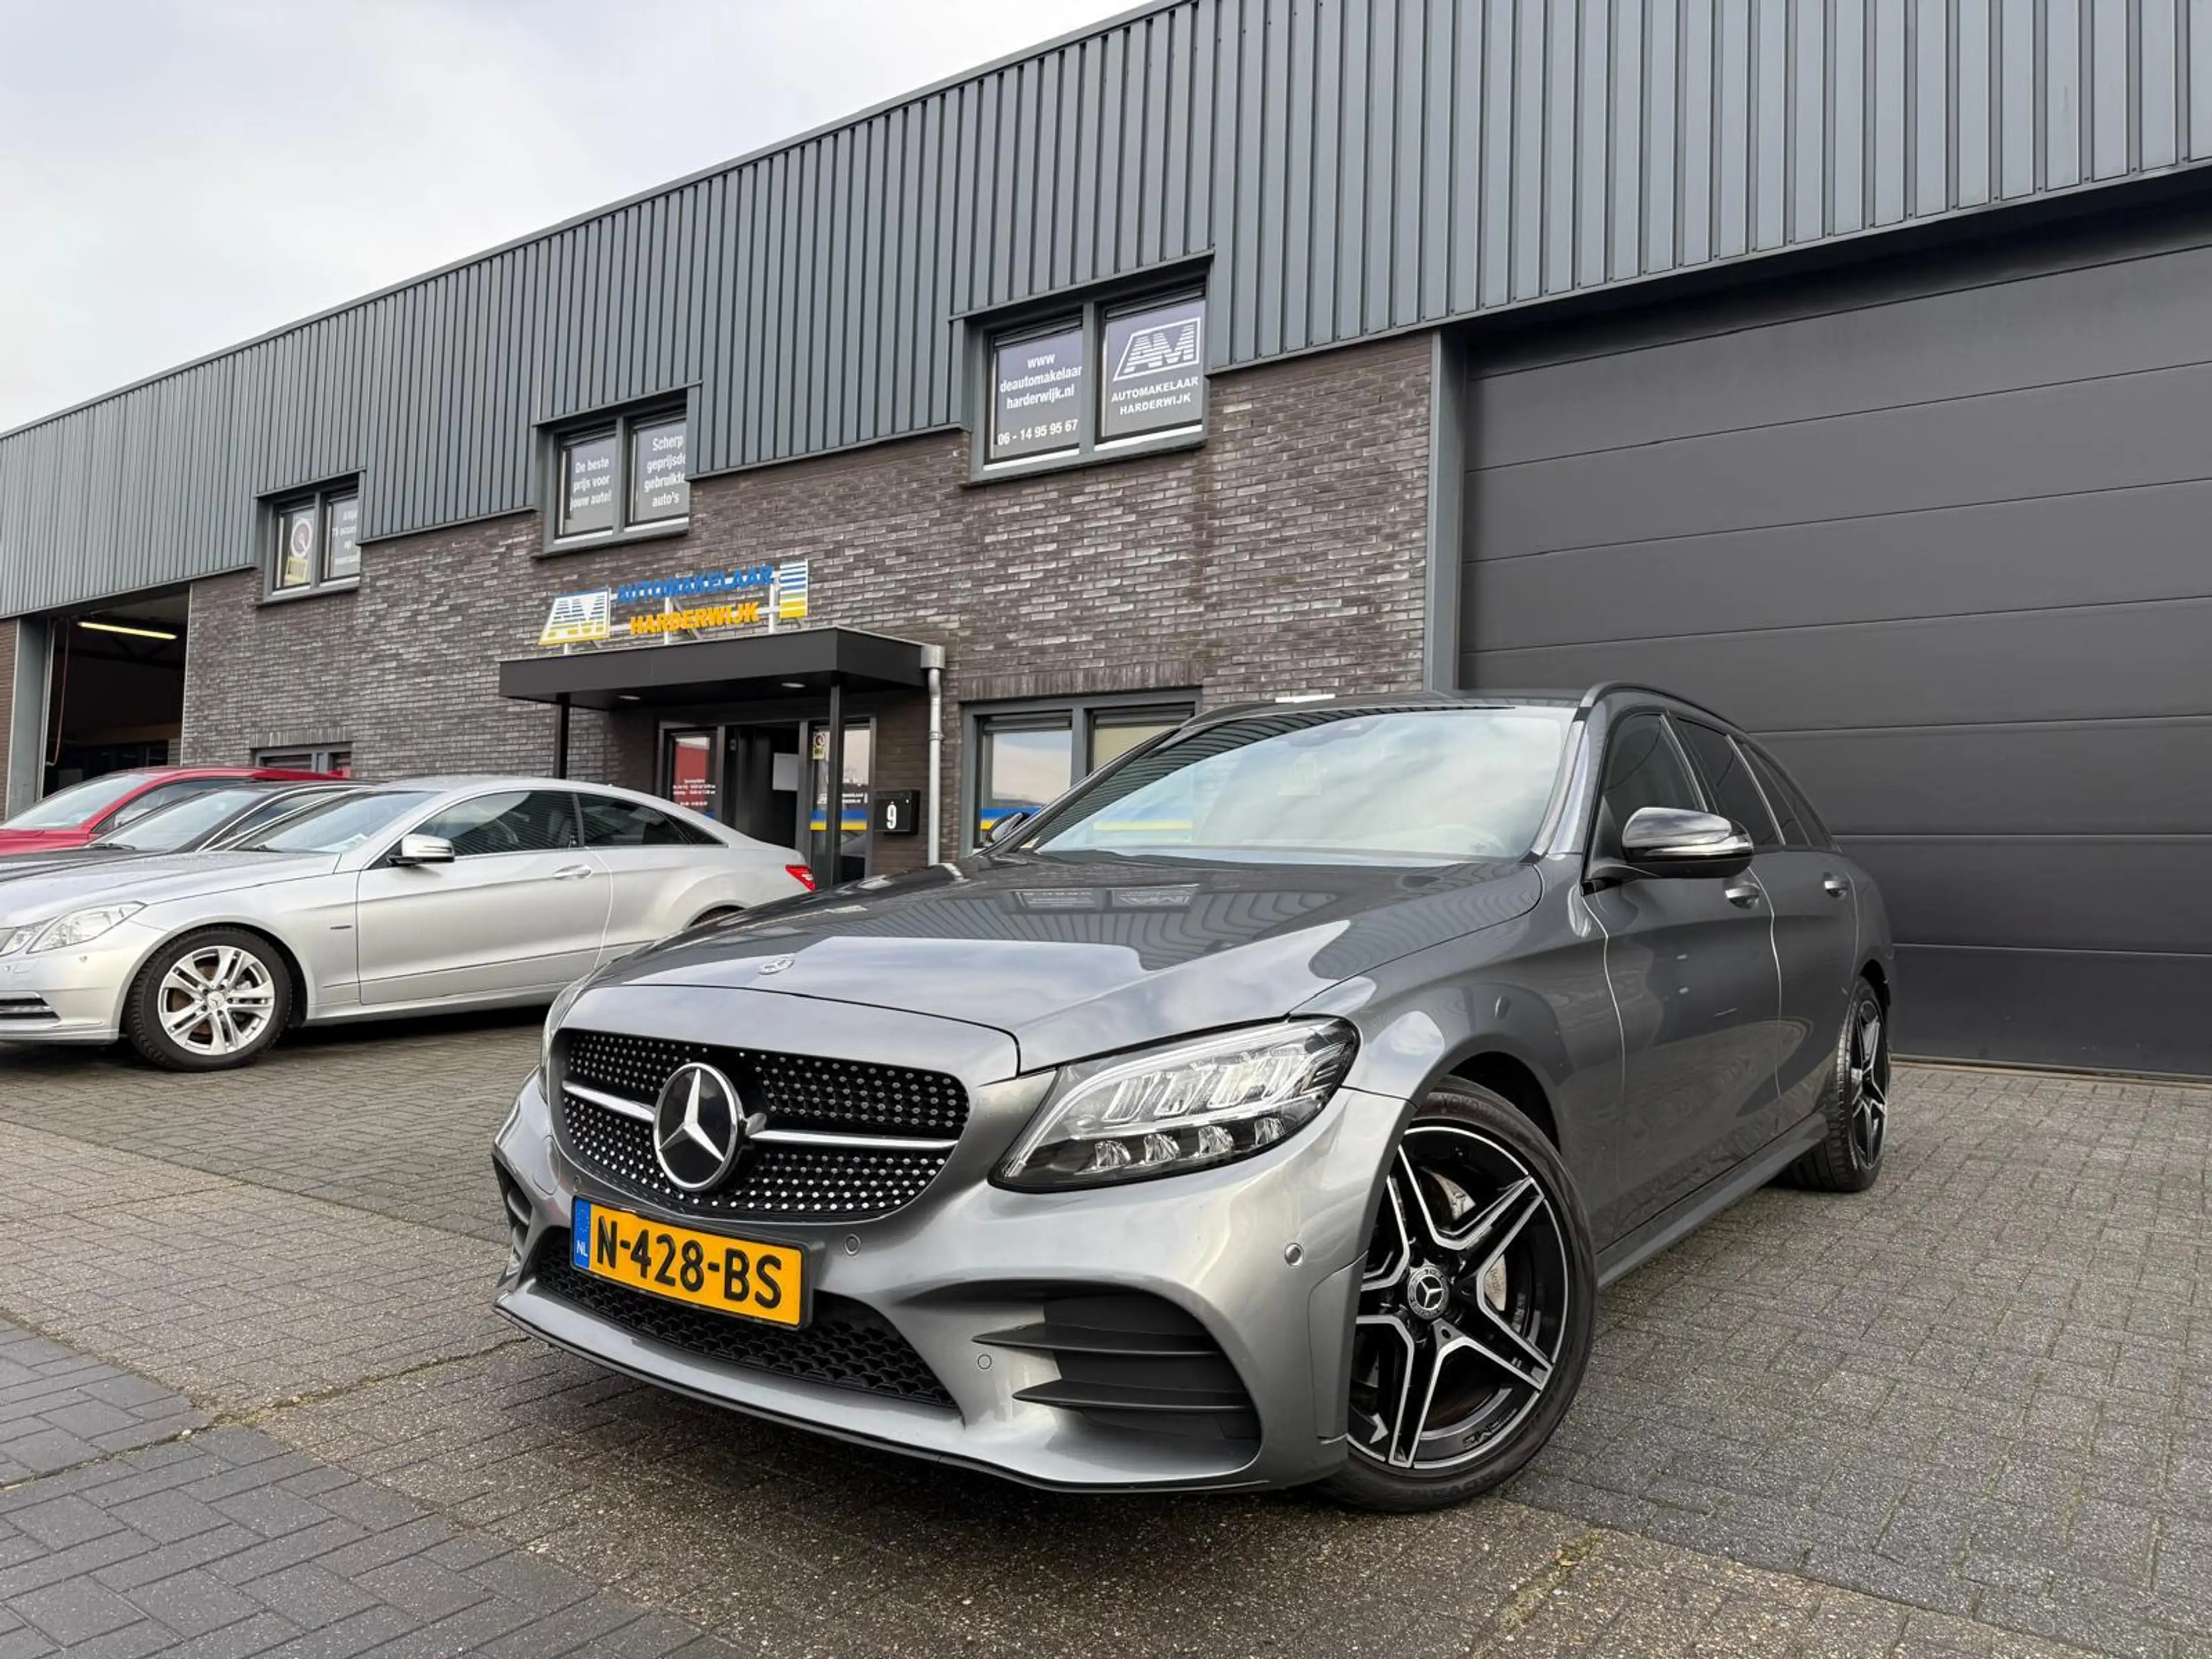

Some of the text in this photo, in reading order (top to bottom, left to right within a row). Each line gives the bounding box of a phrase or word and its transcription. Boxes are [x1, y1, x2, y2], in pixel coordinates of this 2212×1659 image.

[1028, 354, 1055, 369] www
[1000, 366, 1082, 393] deautomakelaar
[1111, 376, 1199, 403] AUTOMAKELAAR
[1006, 383, 1075, 410] harderwijk.nl
[1120, 392, 1191, 415] HARDERWIJK
[1020, 427, 1032, 440] 14
[1035, 425, 1047, 438] 95
[1050, 421, 1062, 435] 95
[652, 435, 684, 452] Scherp
[588, 457, 609, 471] beste
[652, 491, 680, 507] auto's
[616, 563, 774, 604] AUTOMAKELAAR
[630, 601, 760, 635] HARDERWIJK
[887, 804, 897, 829] 9
[576, 1215, 782, 1309] NL N-428-BS
